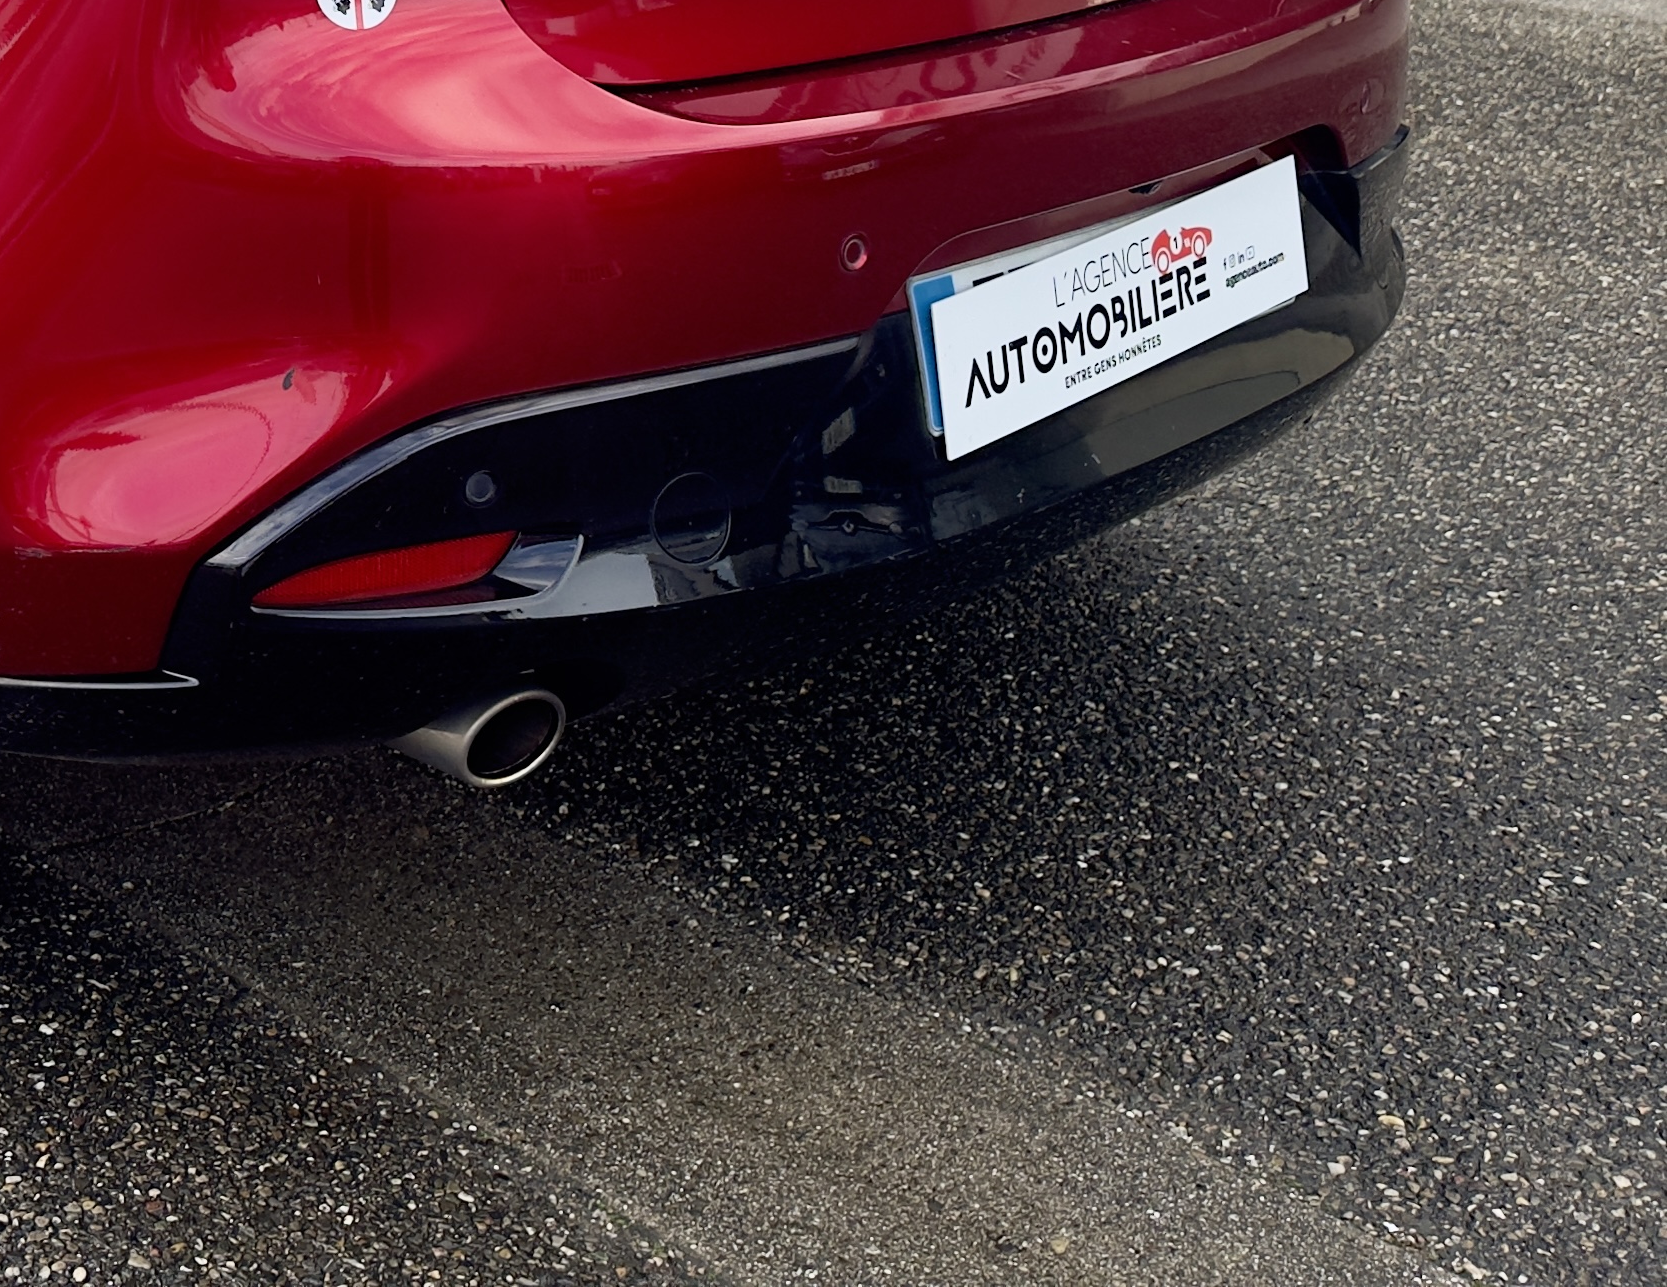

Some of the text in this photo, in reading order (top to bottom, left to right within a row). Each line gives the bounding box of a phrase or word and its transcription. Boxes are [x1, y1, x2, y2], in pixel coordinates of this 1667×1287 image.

[1053, 237, 1153, 308] L'AGENCE
[1064, 333, 1162, 389] ENTRE GENS HONNÊTES
